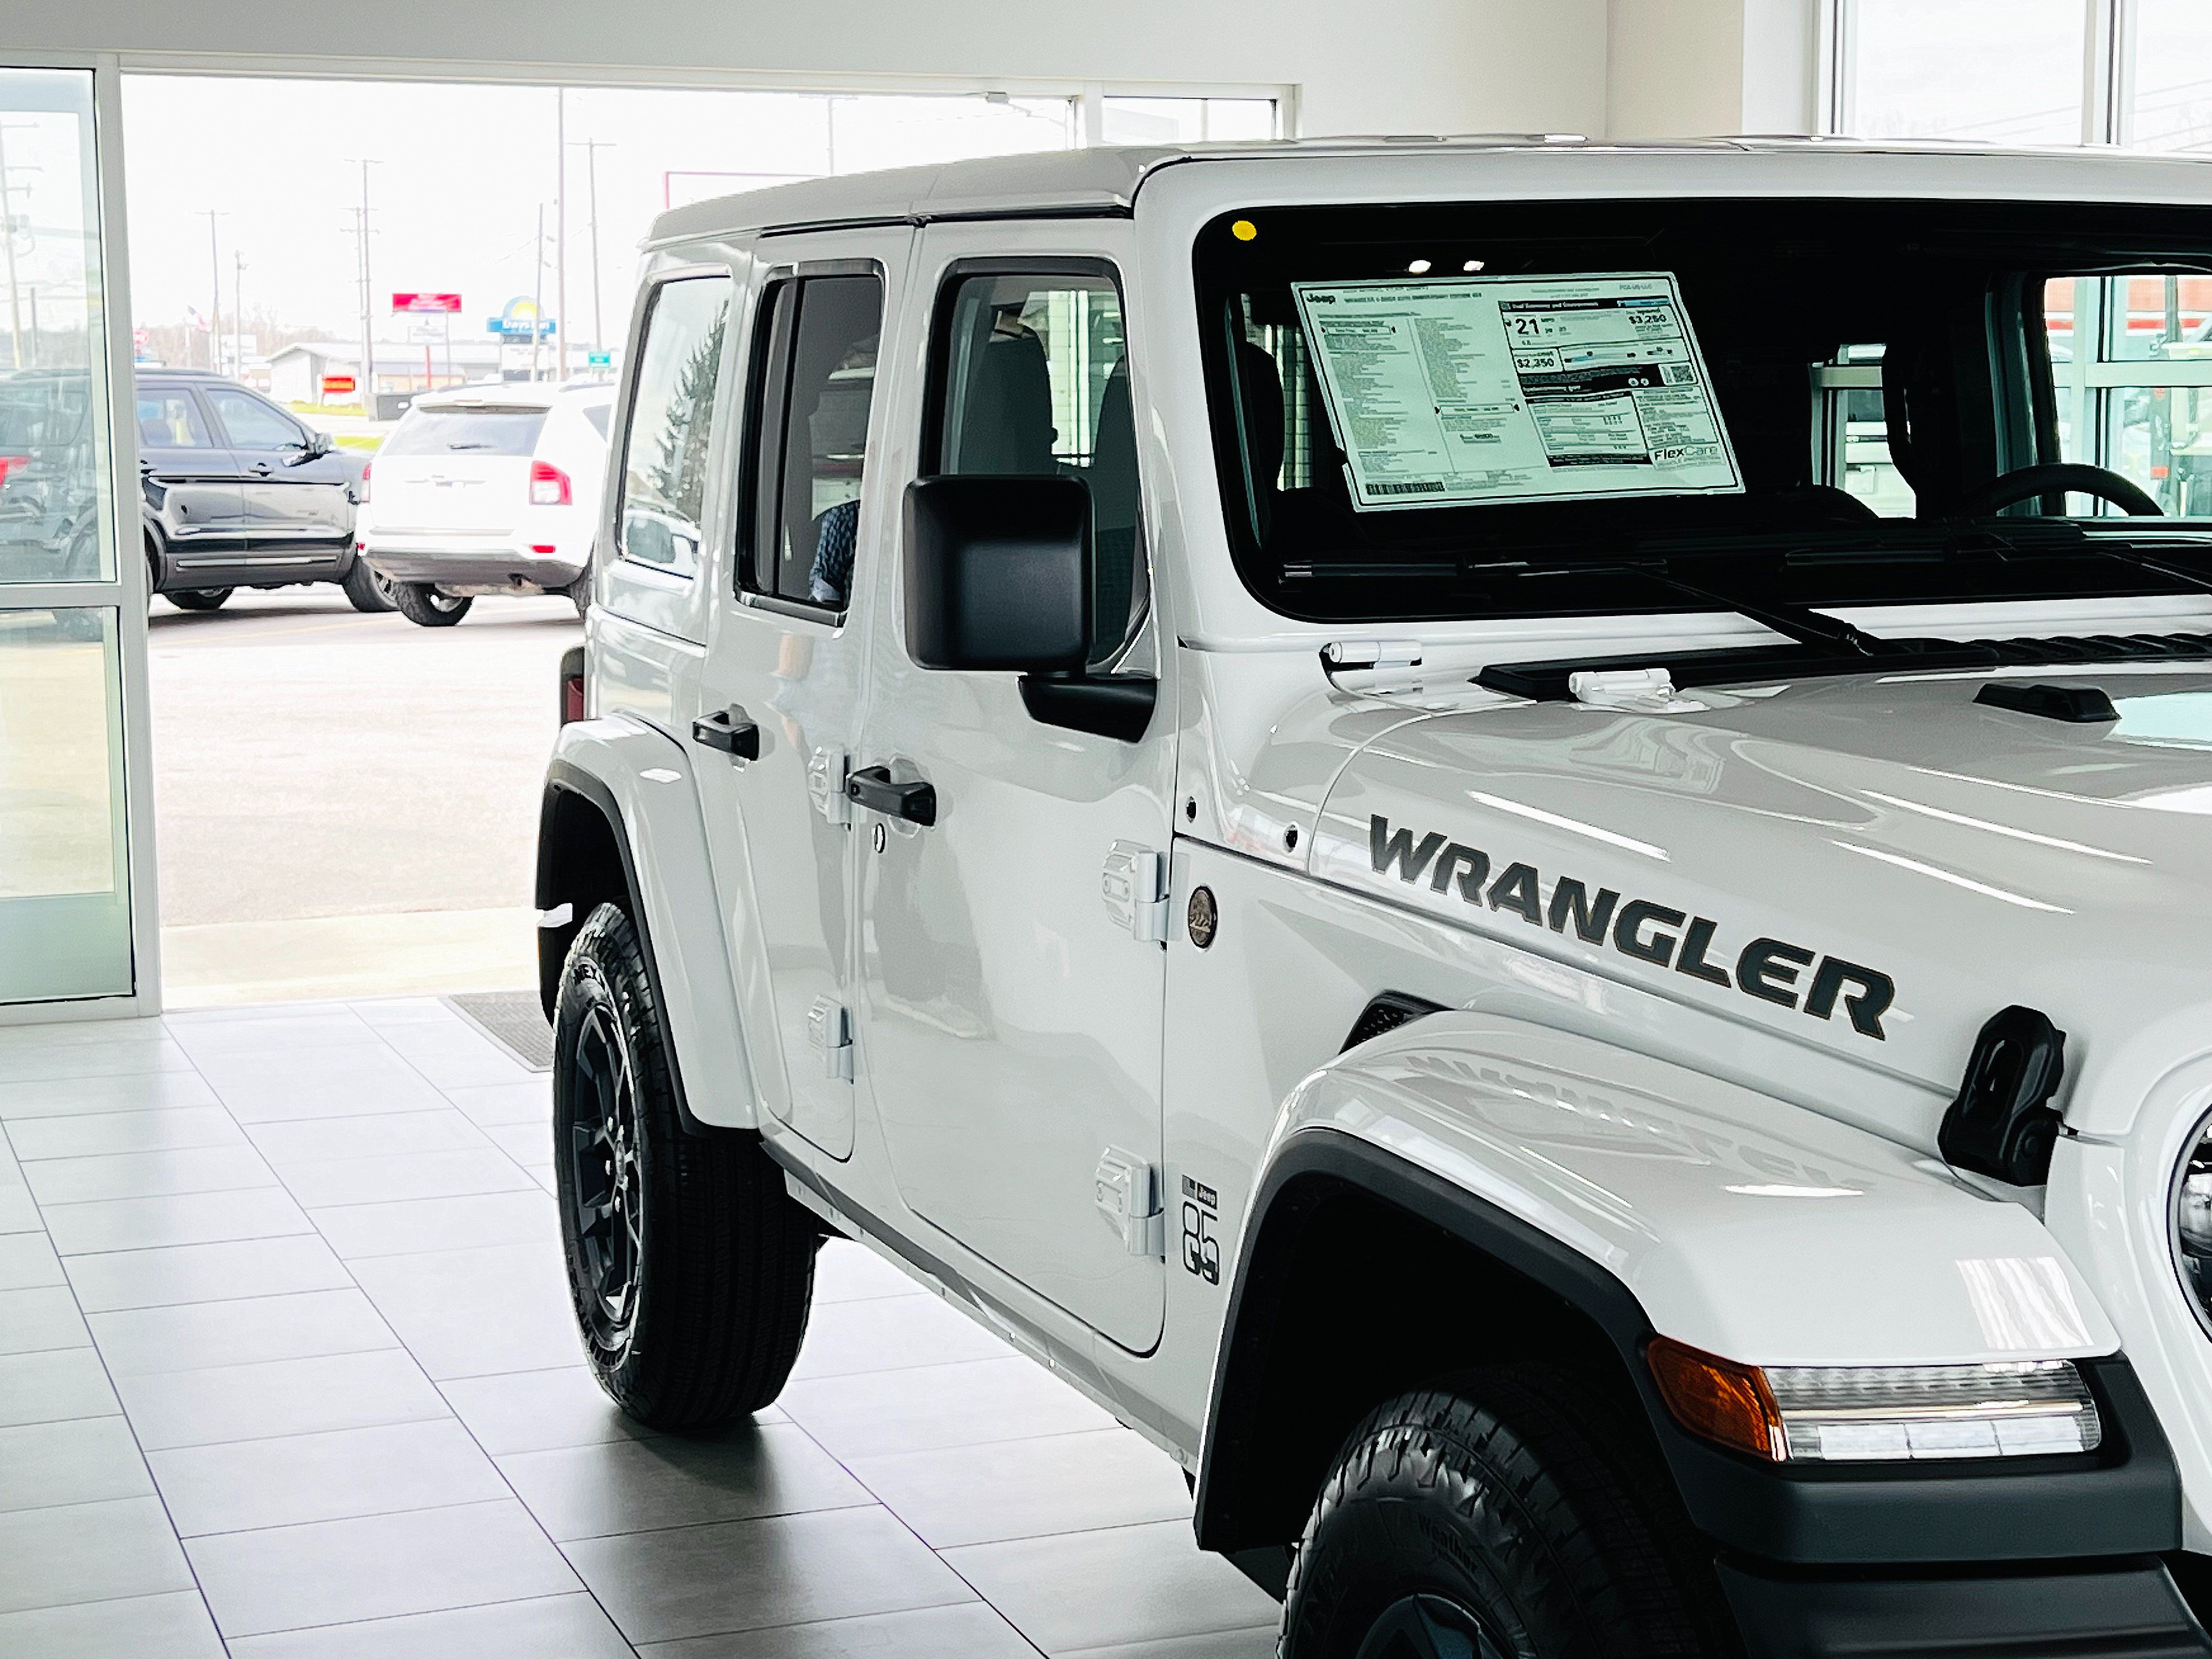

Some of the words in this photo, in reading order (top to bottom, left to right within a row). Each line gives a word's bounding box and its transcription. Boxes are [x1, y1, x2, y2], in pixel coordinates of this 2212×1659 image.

[1306, 293, 1336, 305] Jeep
[1515, 318, 1539, 334] 21
[1516, 357, 1555, 370] $2,350
[1654, 446, 1718, 461] FlexCare
[1370, 814, 1895, 1042] WRANGLER
